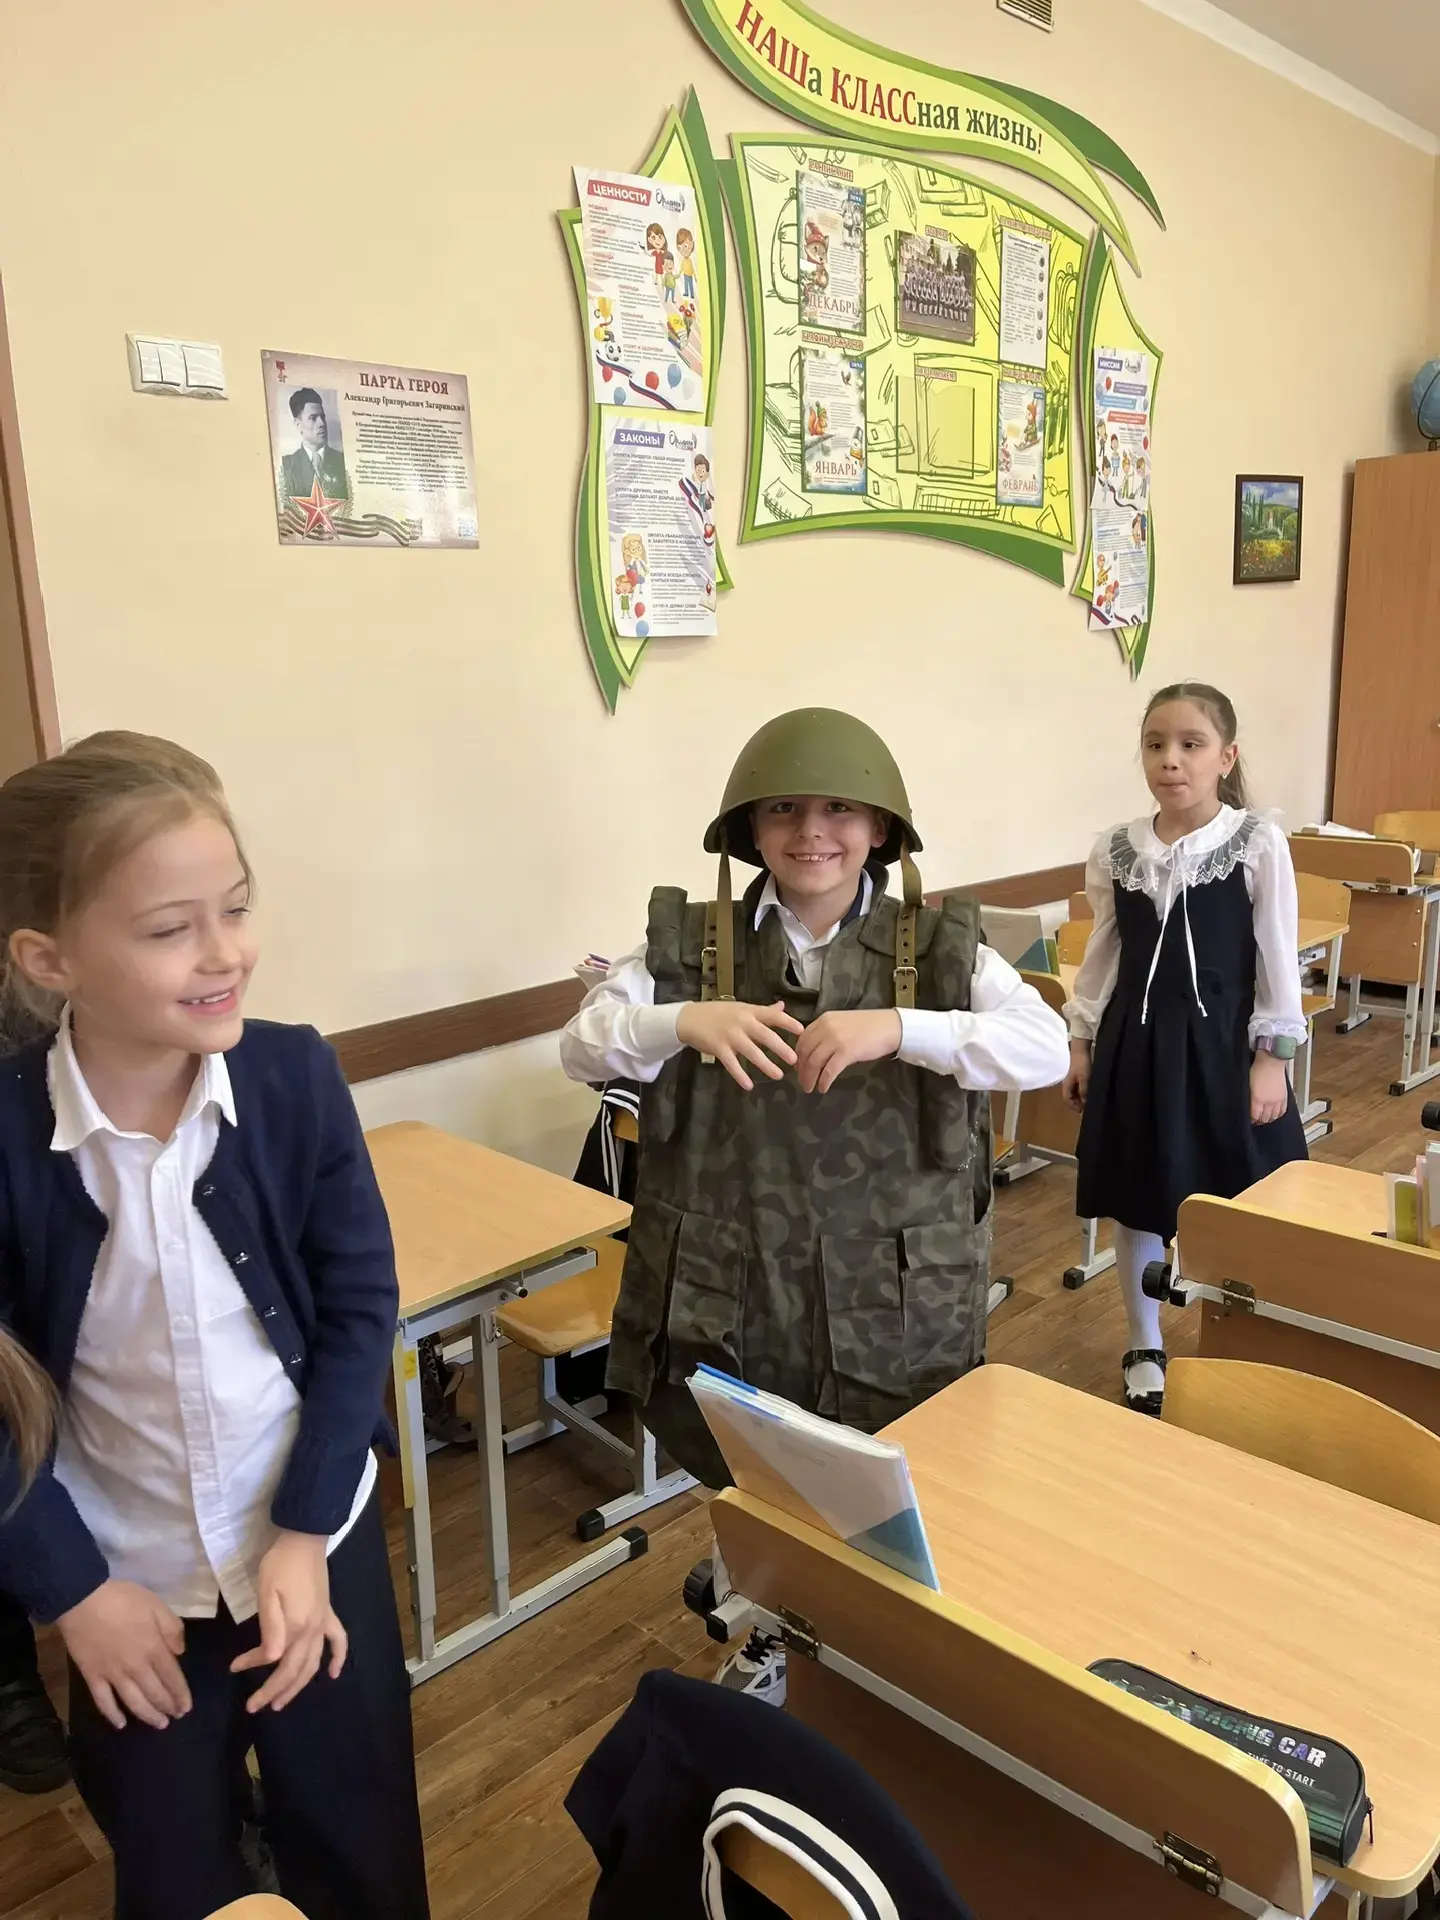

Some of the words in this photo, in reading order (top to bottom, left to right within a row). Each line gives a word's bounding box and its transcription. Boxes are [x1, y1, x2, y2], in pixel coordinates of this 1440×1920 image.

[735, 0, 823, 96] НАШа
[830, 66, 960, 131] КЛАССная
[965, 107, 1043, 155] жизнь!
[592, 183, 648, 203] ЦЕННОСТИ
[809, 294, 858, 315] ДЕКАБРЬ
[359, 373, 405, 390] ПАРТА
[407, 378, 449, 395] ГЕРОЯ
[344, 392, 381, 405] Александр
[382, 396, 424, 408] Григорьевич
[619, 433, 660, 445] ЗАКОНЫ
[815, 461, 857, 475] ЯНВАРЬ
[1002, 478, 1039, 491] ФЕВРАЛЬ
[1278, 1736, 1327, 1768] CAR
[1271, 1762, 1284, 1773] TO
[1284, 1768, 1316, 1787] START
